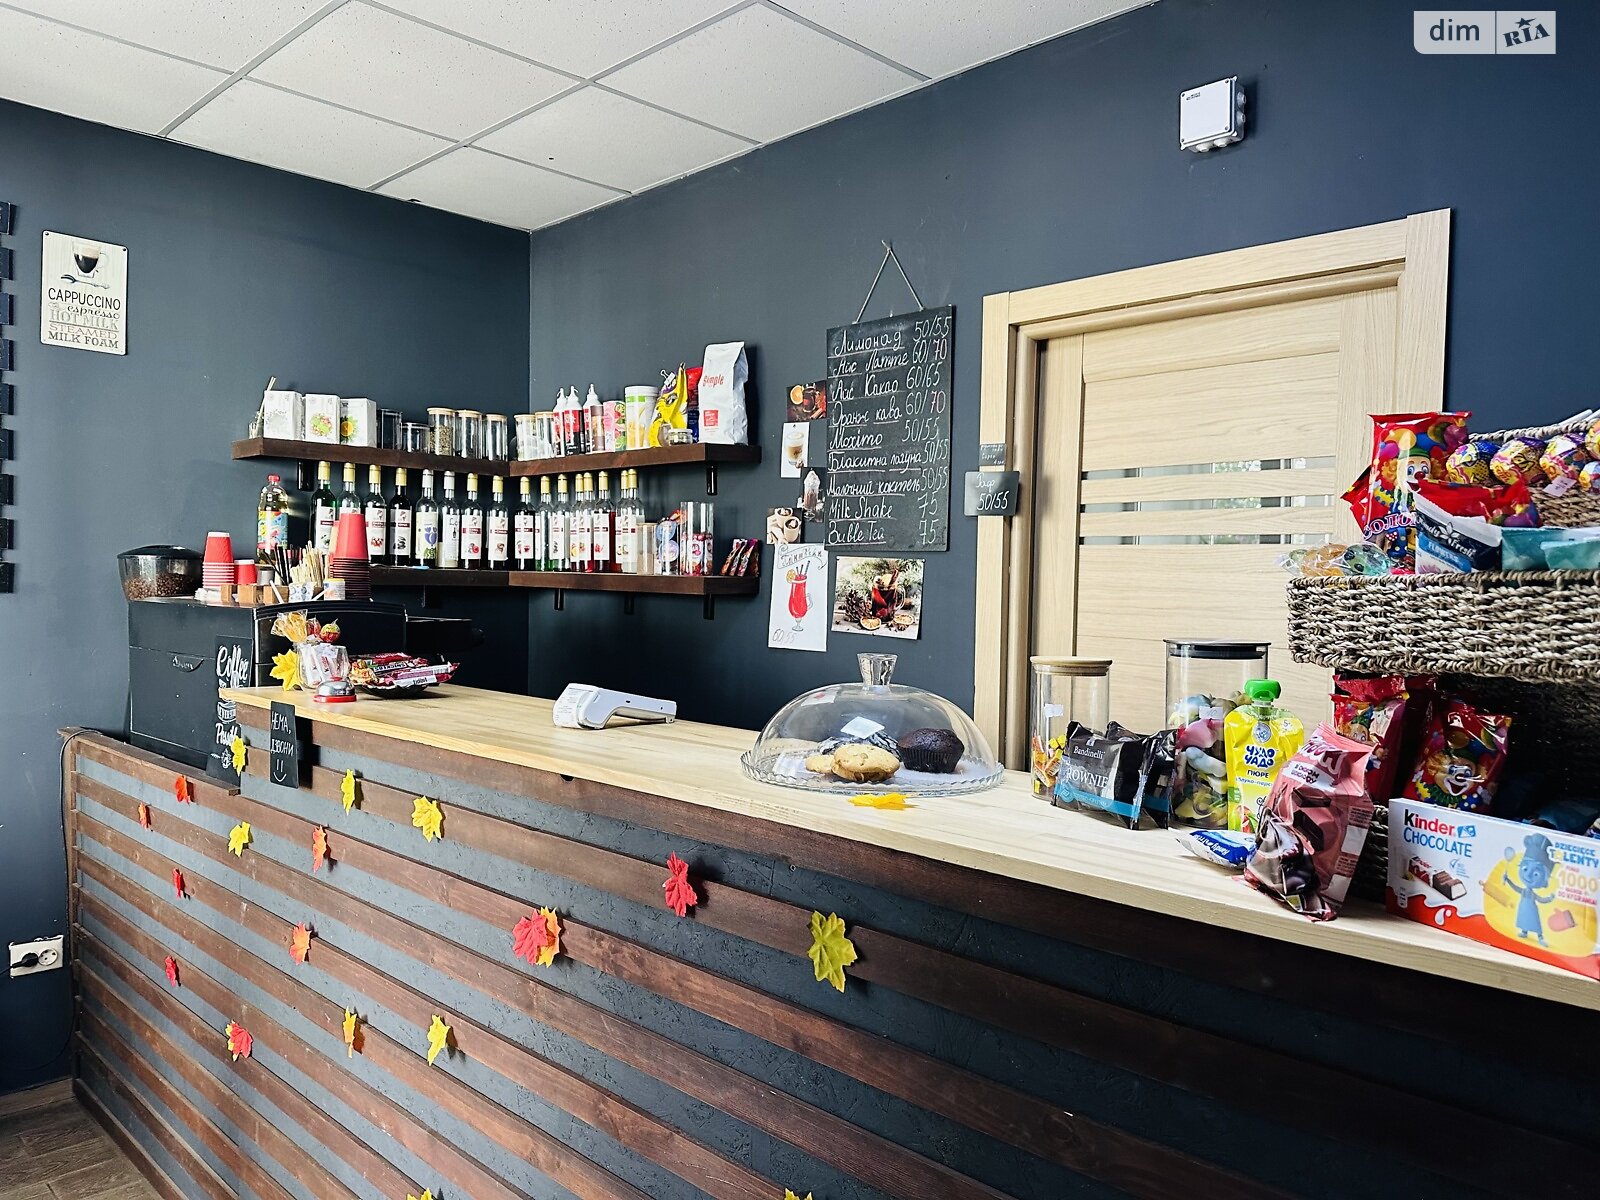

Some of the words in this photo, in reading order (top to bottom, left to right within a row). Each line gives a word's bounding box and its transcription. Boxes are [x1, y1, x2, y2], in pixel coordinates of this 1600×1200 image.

[48, 287, 121, 311] CAPPUCCINO
[50, 309, 80, 324] HOT
[83, 315, 118, 330] MILK
[67, 305, 120, 319] espresso
[48, 331, 81, 344] MILK
[84, 335, 119, 349] FOAM
[49, 322, 118, 340] STEAMED
[834, 330, 902, 357] Лимонад
[913, 315, 951, 342] 50/55
[866, 349, 909, 371] Латте
[865, 373, 899, 397] Какао
[906, 362, 942, 389] 60/65
[876, 396, 903, 420] кава
[906, 390, 946, 415] 60/70
[902, 417, 939, 442] 50/55
[827, 451, 887, 472] Блакитна
[890, 453, 921, 474] лагуна
[922, 439, 949, 464] 50/55
[921, 467, 948, 492] 50/55
[829, 499, 851, 519] Milk
[855, 496, 893, 519] Shake
[918, 491, 938, 519] 75
[976, 491, 1010, 511] 50/55
[868, 520, 885, 541] Tea
[919, 518, 939, 545] 75
[1450, 540, 1476, 558] Fresh
[216, 645, 249, 690] Coffee
[1073, 745, 1104, 760] Bandinelli
[1244, 754, 1275, 769] ЧАДО
[1246, 745, 1275, 758] ЧУДО
[1247, 769, 1270, 779] ПЮРЕ
[1404, 808, 1456, 836] Kinder
[1403, 826, 1473, 858] CHOCOLATE
[1549, 848, 1600, 868] TLENTY
[1559, 870, 1598, 893] 1000
